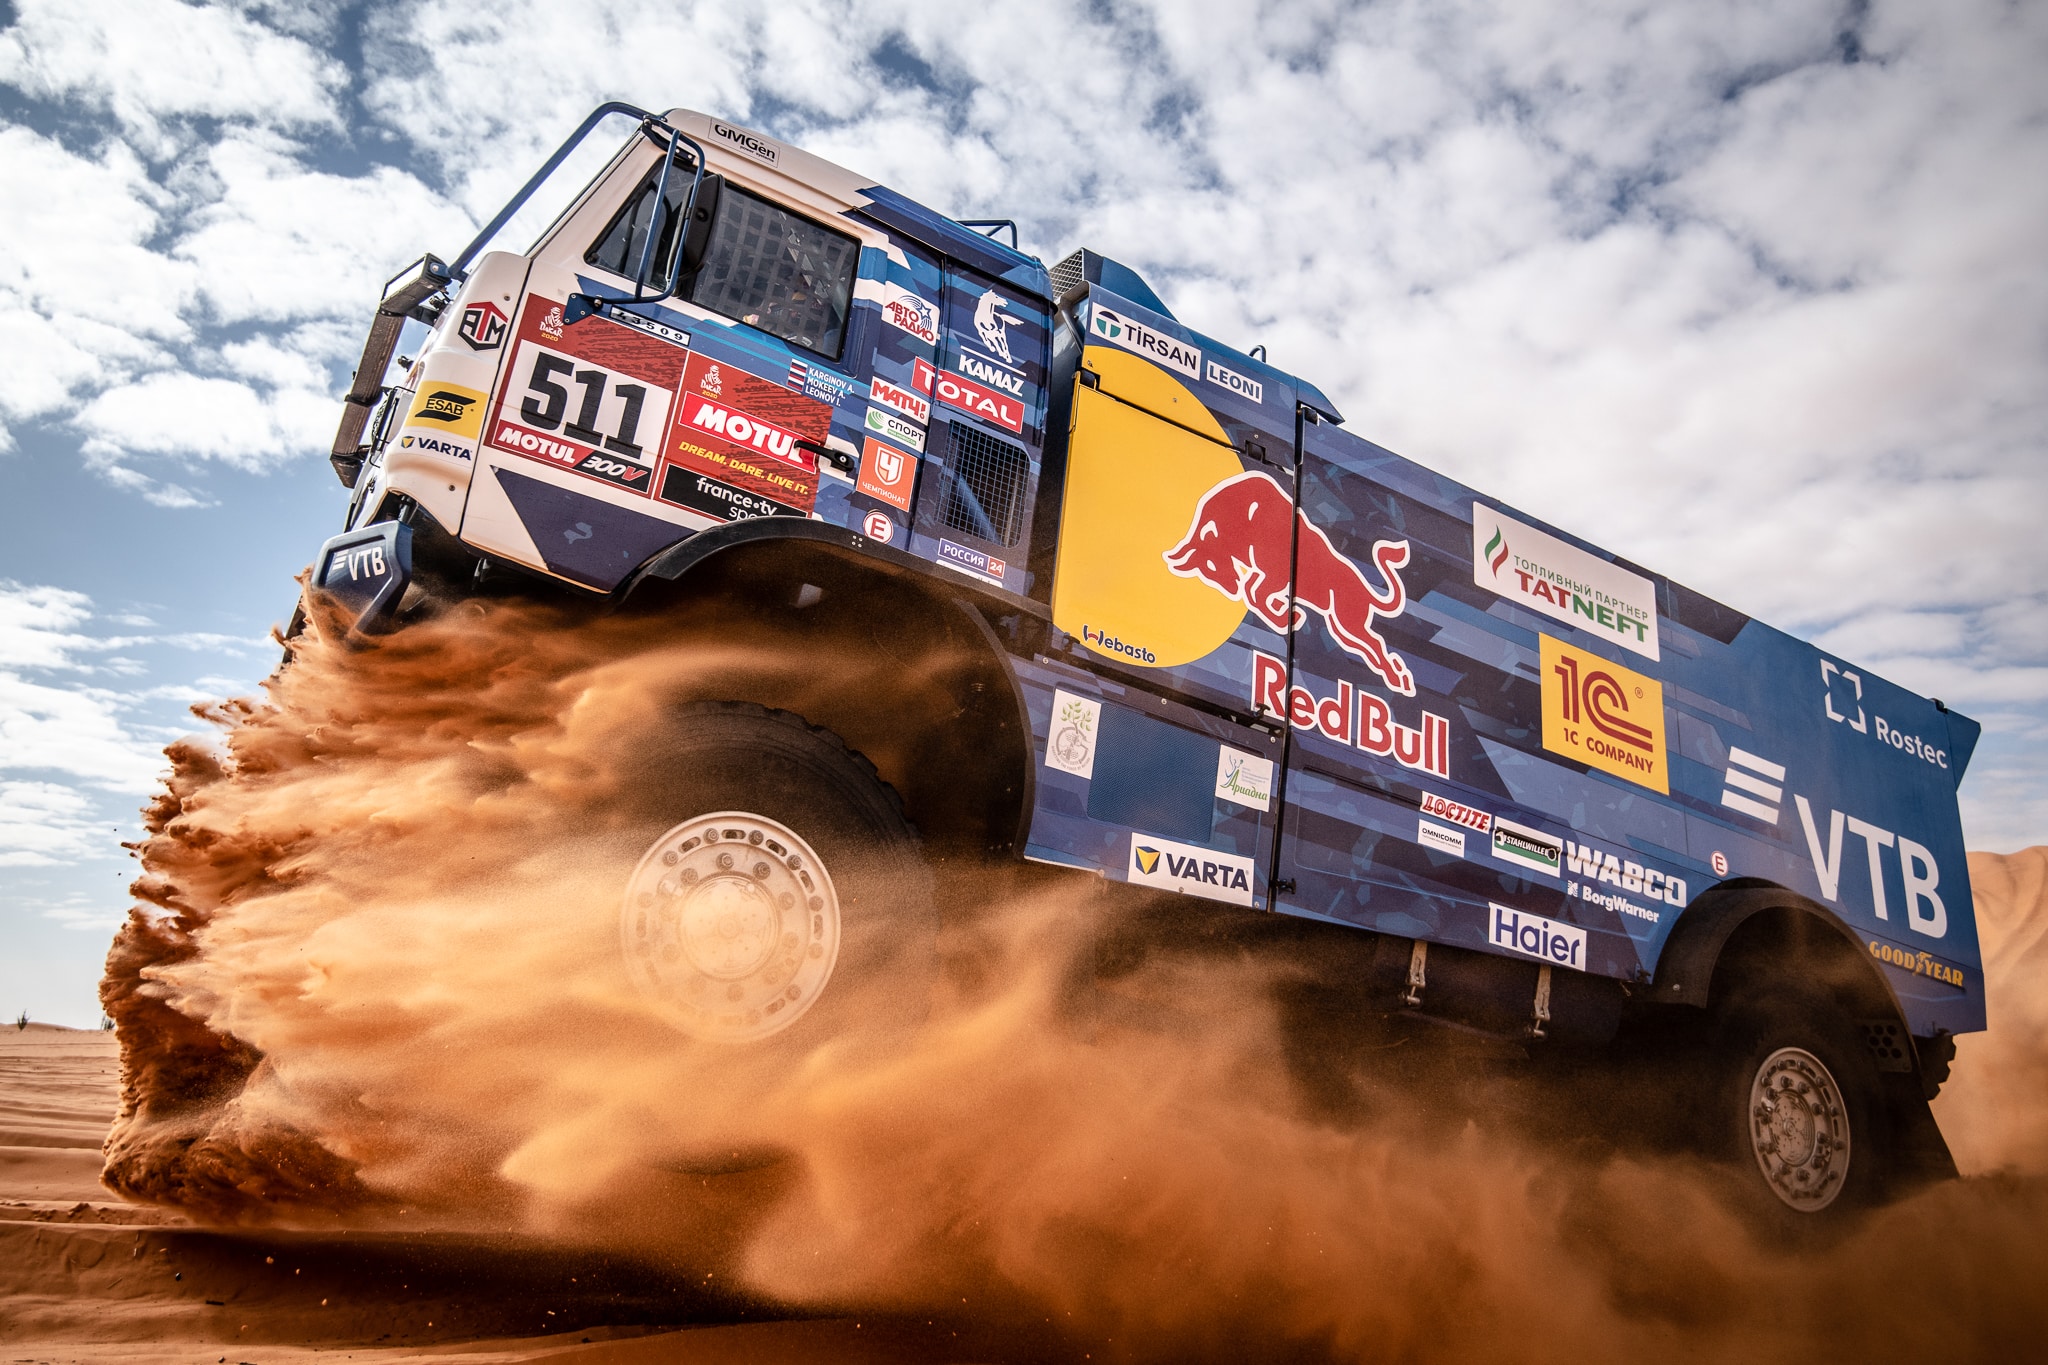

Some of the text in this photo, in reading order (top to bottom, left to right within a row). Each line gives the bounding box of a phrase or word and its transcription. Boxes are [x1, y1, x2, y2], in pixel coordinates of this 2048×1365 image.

[714, 124, 775, 159] GMGen
[885, 301, 919, 322] АВТО
[893, 313, 934, 342] РАДИО
[541, 332, 559, 342] 2020
[807, 376, 846, 399] MOKEEV A.
[808, 367, 855, 393] KARGINOV A.
[959, 354, 1025, 397] KAMAZ
[1209, 365, 1260, 400] LEONI
[425, 399, 464, 416] ESAB
[520, 351, 647, 460] 511
[702, 389, 718, 399] 2020
[805, 386, 836, 403] LEONOV
[919, 365, 1017, 426] TOTAL
[888, 419, 924, 441] СПОРТ
[418, 437, 471, 461] VARTA
[499, 427, 649, 481] MOTUL 300V
[678, 441, 809, 495] DREAM. DARE. LIVE IT.
[862, 481, 906, 504] ЧЕМПИОНАТ
[869, 517, 887, 540] E
[348, 546, 386, 581] VTB
[943, 544, 1003, 573] РОССИЯ 24
[1513, 555, 1649, 621] ТОПЛИВНЫЙ ПАРТНЕР
[1514, 568, 1649, 643] TATNEFT
[1083, 624, 1156, 664] Webasto
[1563, 727, 1654, 774] 1C COMPANY
[1874, 715, 1948, 769] Rostec
[1422, 795, 1490, 831] LOCTITE
[1421, 827, 1462, 846] OMNICOMM
[1506, 836, 1547, 857] STAHLWILLE
[1165, 852, 1250, 892] VARTA
[1566, 840, 1687, 908] WABCO
[1715, 855, 1725, 872] E
[1793, 793, 1948, 939] VTB
[1582, 885, 1660, 923] BorgWarner
[1495, 908, 1580, 966] Haier
[1868, 941, 1964, 987] GOODYEAR
